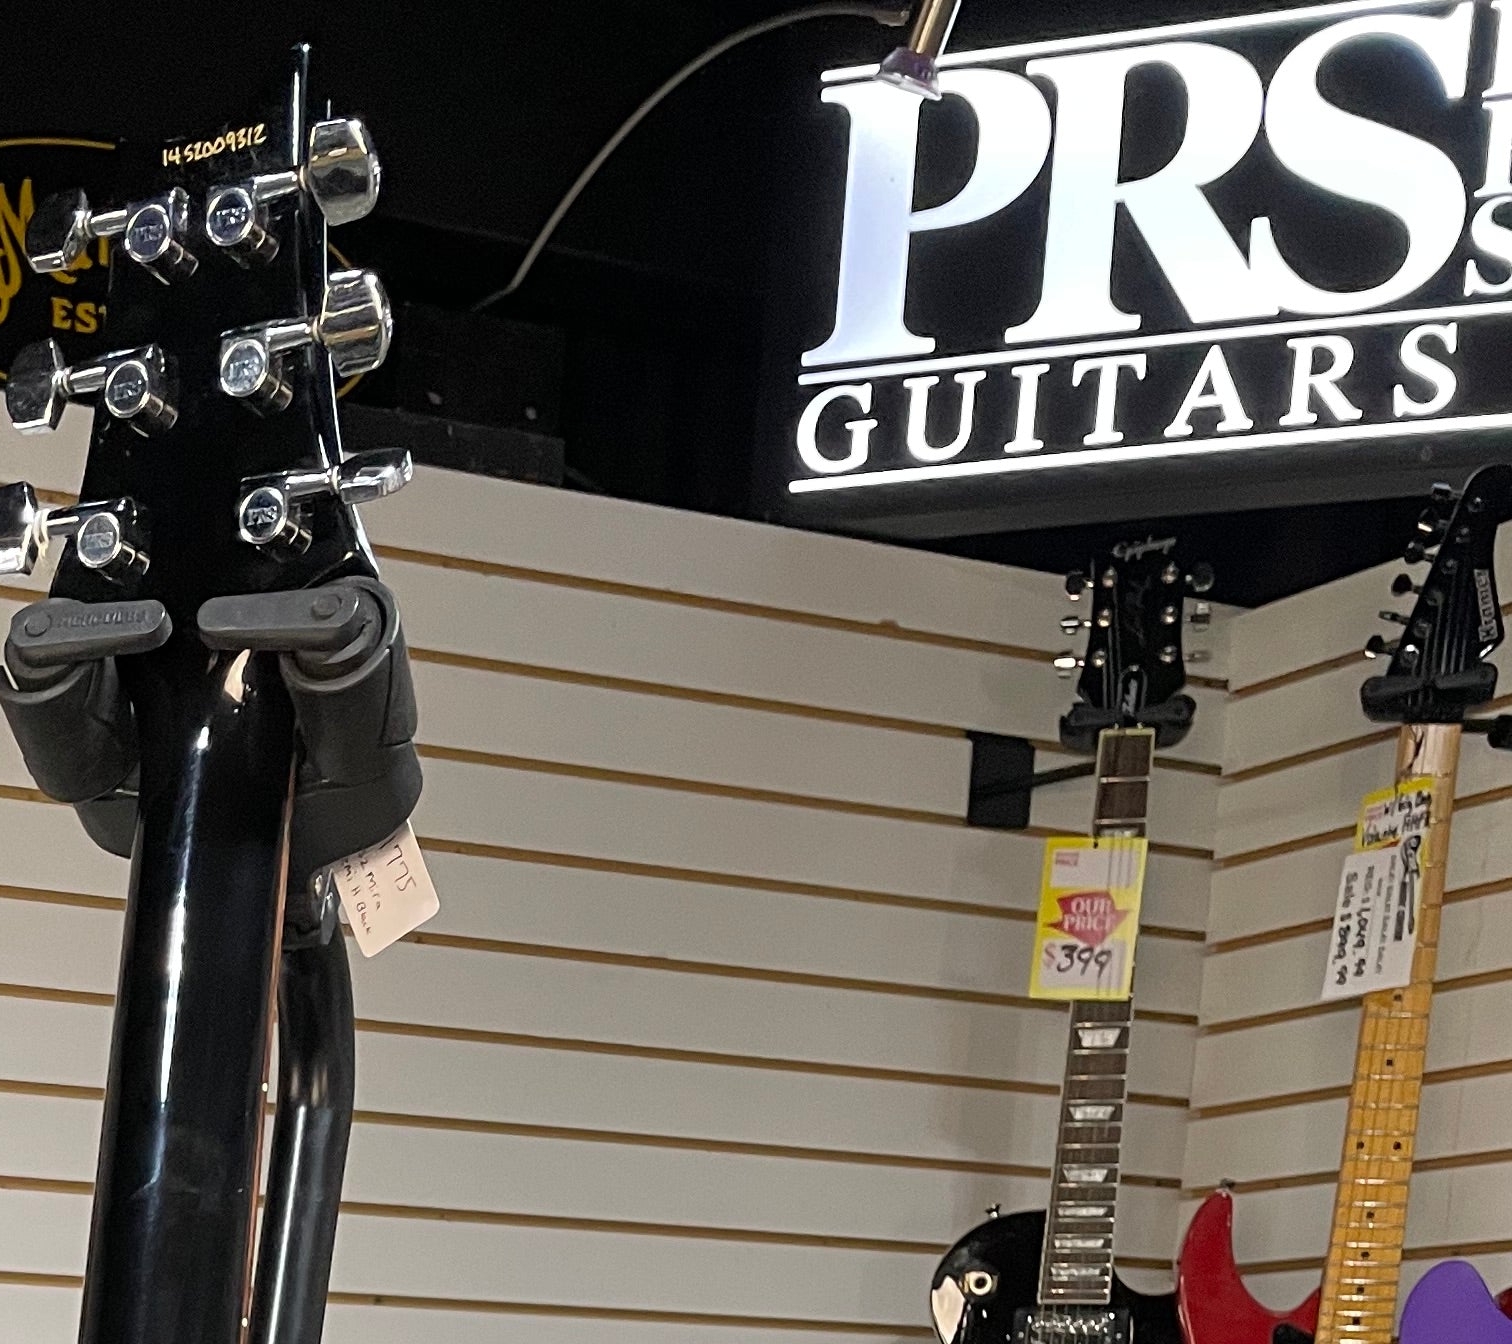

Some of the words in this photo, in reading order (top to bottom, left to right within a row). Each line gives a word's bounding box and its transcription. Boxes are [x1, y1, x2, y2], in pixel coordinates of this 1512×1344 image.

[801, 2, 1475, 367] PRS
[796, 323, 1459, 474] GUITARS
[1063, 913, 1115, 932] PRICE
[1070, 896, 1112, 915] OUR
